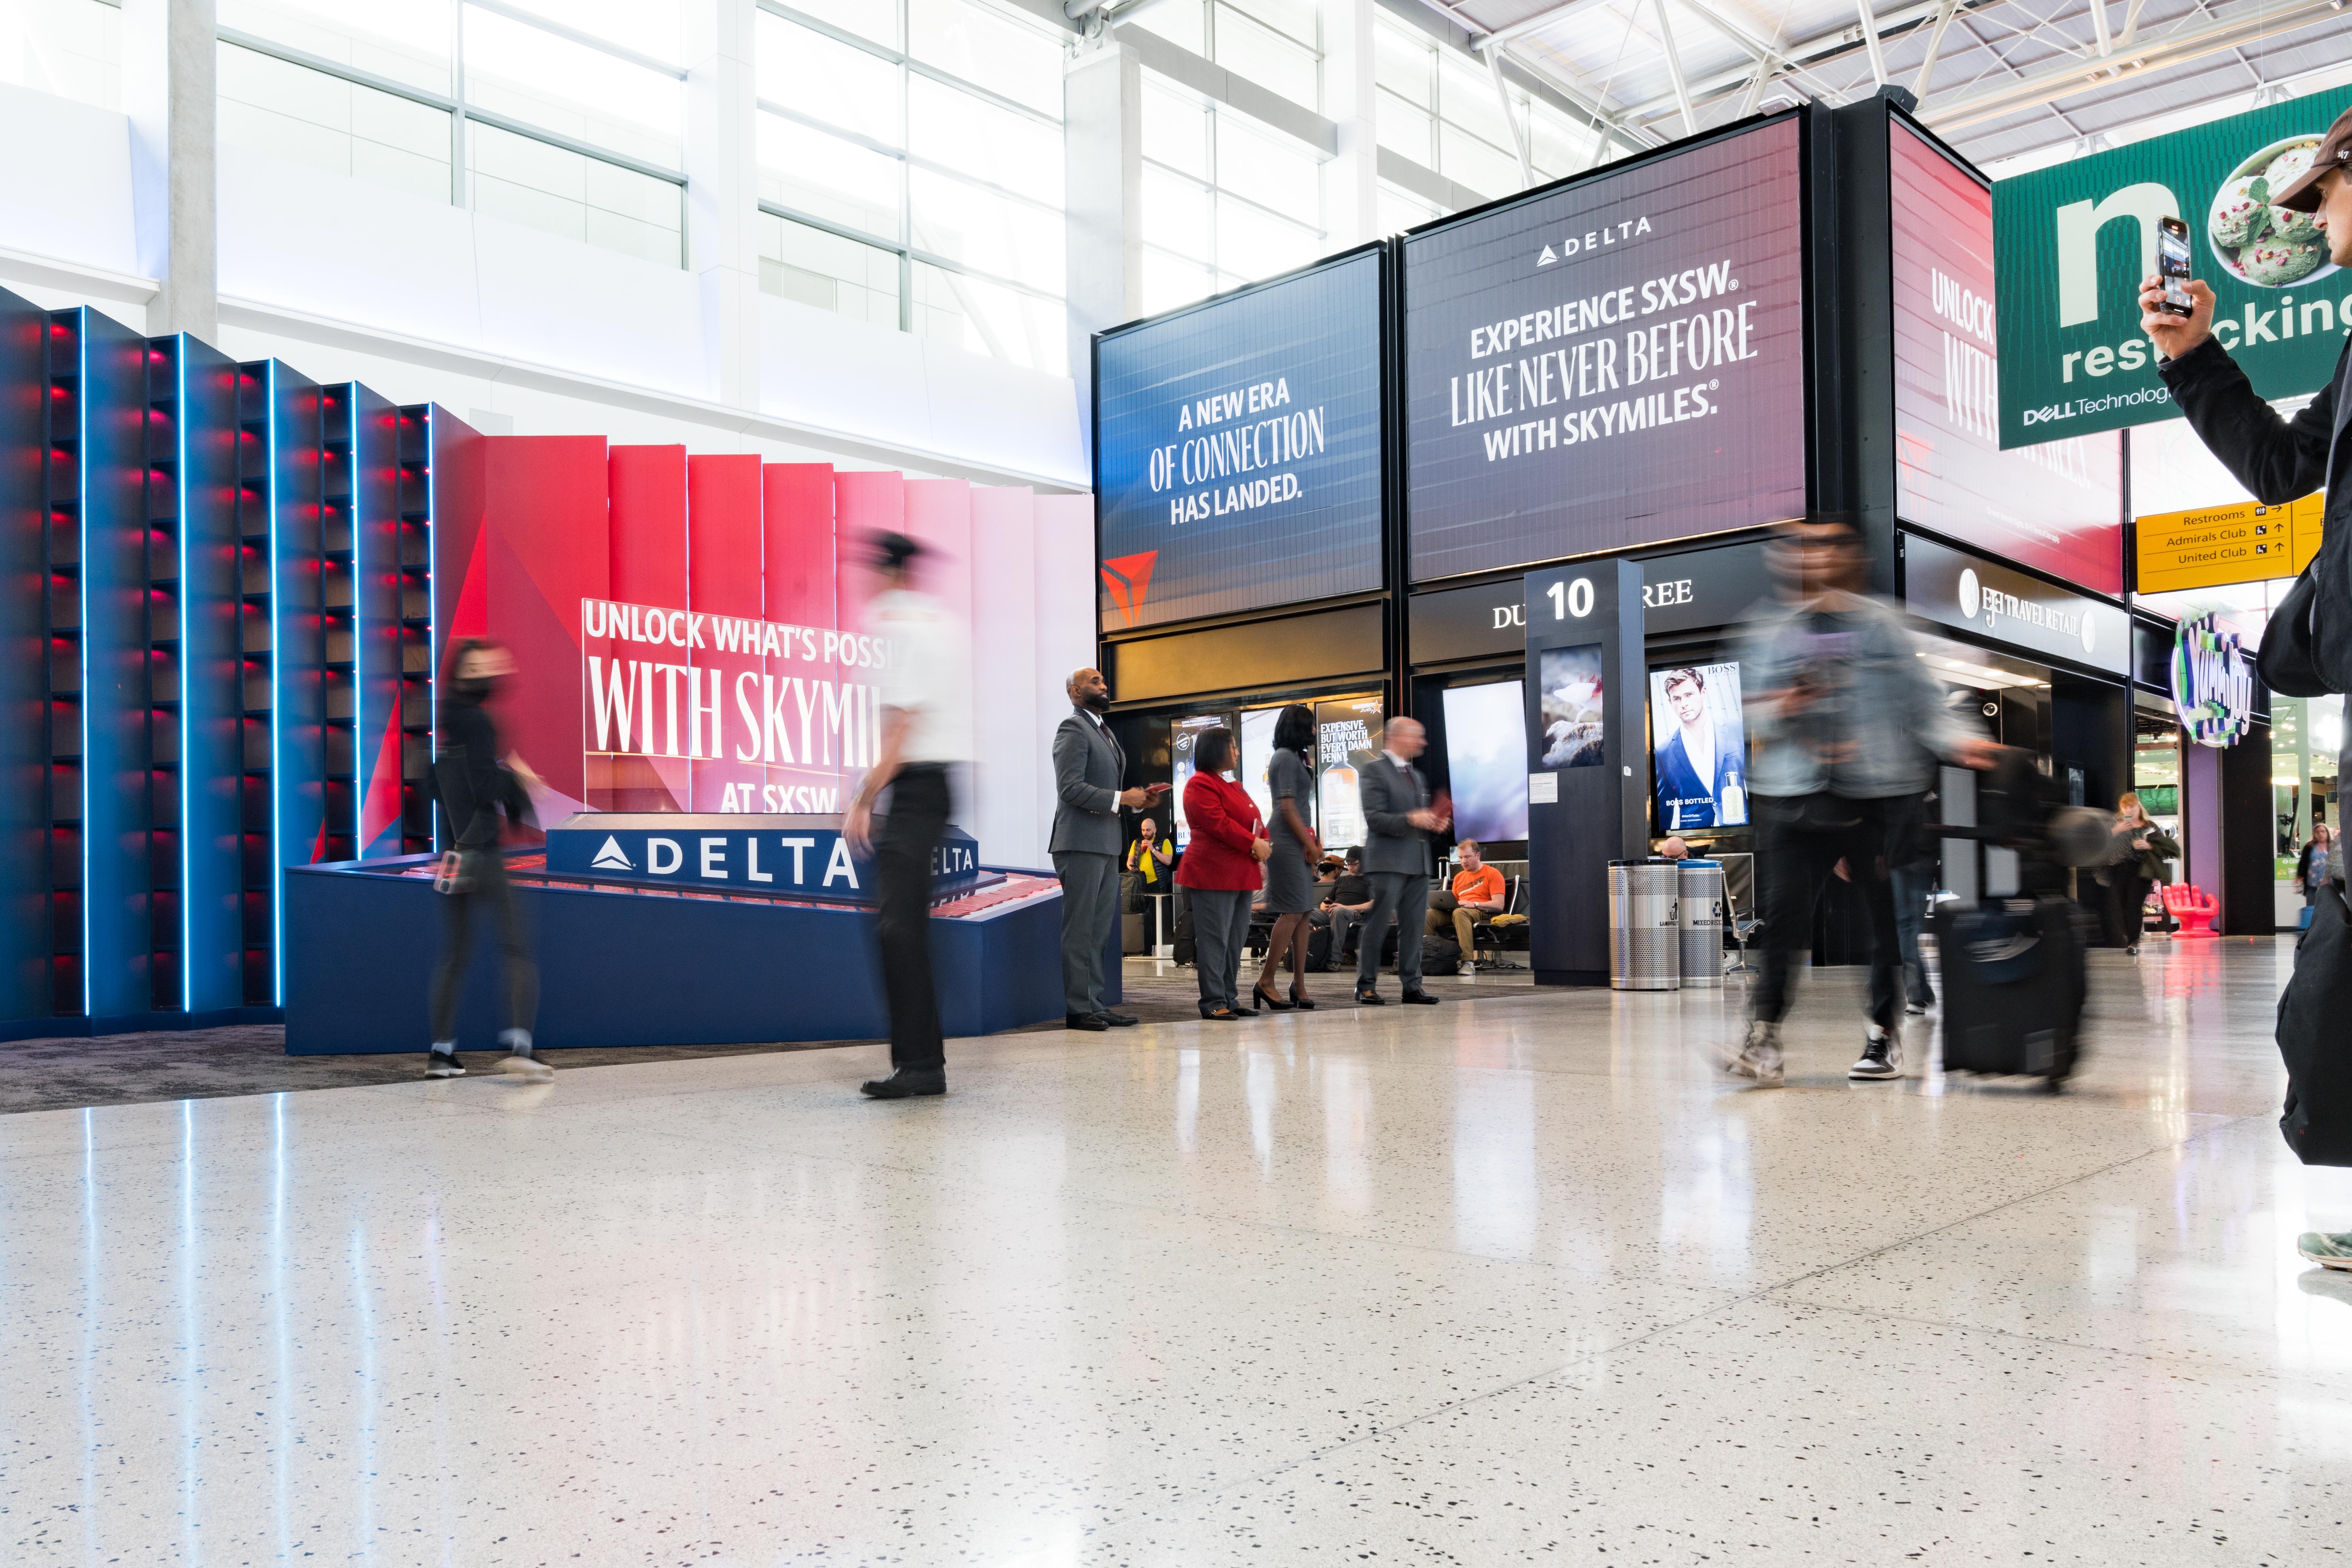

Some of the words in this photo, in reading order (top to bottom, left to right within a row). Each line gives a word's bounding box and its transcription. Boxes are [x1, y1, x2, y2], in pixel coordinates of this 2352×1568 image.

[1565, 216, 1652, 257] DELTA
[1471, 286, 1636, 359] EXPERIENCE
[1932, 267, 1994, 345] UNLOCK
[1451, 363, 1513, 427] LIKE
[1520, 338, 1619, 411] NEVER
[1627, 300, 1758, 386] BEFORE
[1178, 404, 1193, 432] A
[1197, 389, 1244, 428] NEW
[1248, 377, 1290, 414] ERA
[1943, 330, 1999, 444] WITH
[2023, 402, 2076, 426] DELL
[1149, 444, 1177, 492] OF
[1182, 406, 1325, 484] CONNECTION
[1483, 416, 1557, 462] WITH
[1171, 492, 1211, 525] HAS
[1214, 473, 1303, 516] LANDED.
[2183, 510, 2245, 525] Restrooms
[2166, 532, 2216, 547] Admirals
[2220, 528, 2246, 540] Club
[2179, 550, 2216, 563] United
[2221, 547, 2247, 558] Club
[1493, 604, 1526, 629] DU
[1642, 579, 1694, 609] REE
[1546, 578, 1594, 620] 10
[2005, 594, 2045, 626] TRAVEL
[2045, 608, 2079, 637] RETAIL
[585, 600, 706, 649] UNLOCK
[711, 616, 817, 662] WHAT'S
[824, 631, 892, 670] POSSI
[1708, 663, 1736, 674] BOSS
[588, 656, 723, 759] WITH
[1320, 719, 1366, 733] EXPENSIVE.
[1321, 733, 1335, 743] BUT
[1337, 729, 1368, 742] WORTH
[1321, 741, 1347, 753] EVERY
[1348, 739, 1372, 751] DAMN
[1321, 751, 1348, 763] PENNY.
[719, 782, 756, 813] AT
[648, 837, 860, 889] DELTA
[930, 847, 973, 876] ELTA
